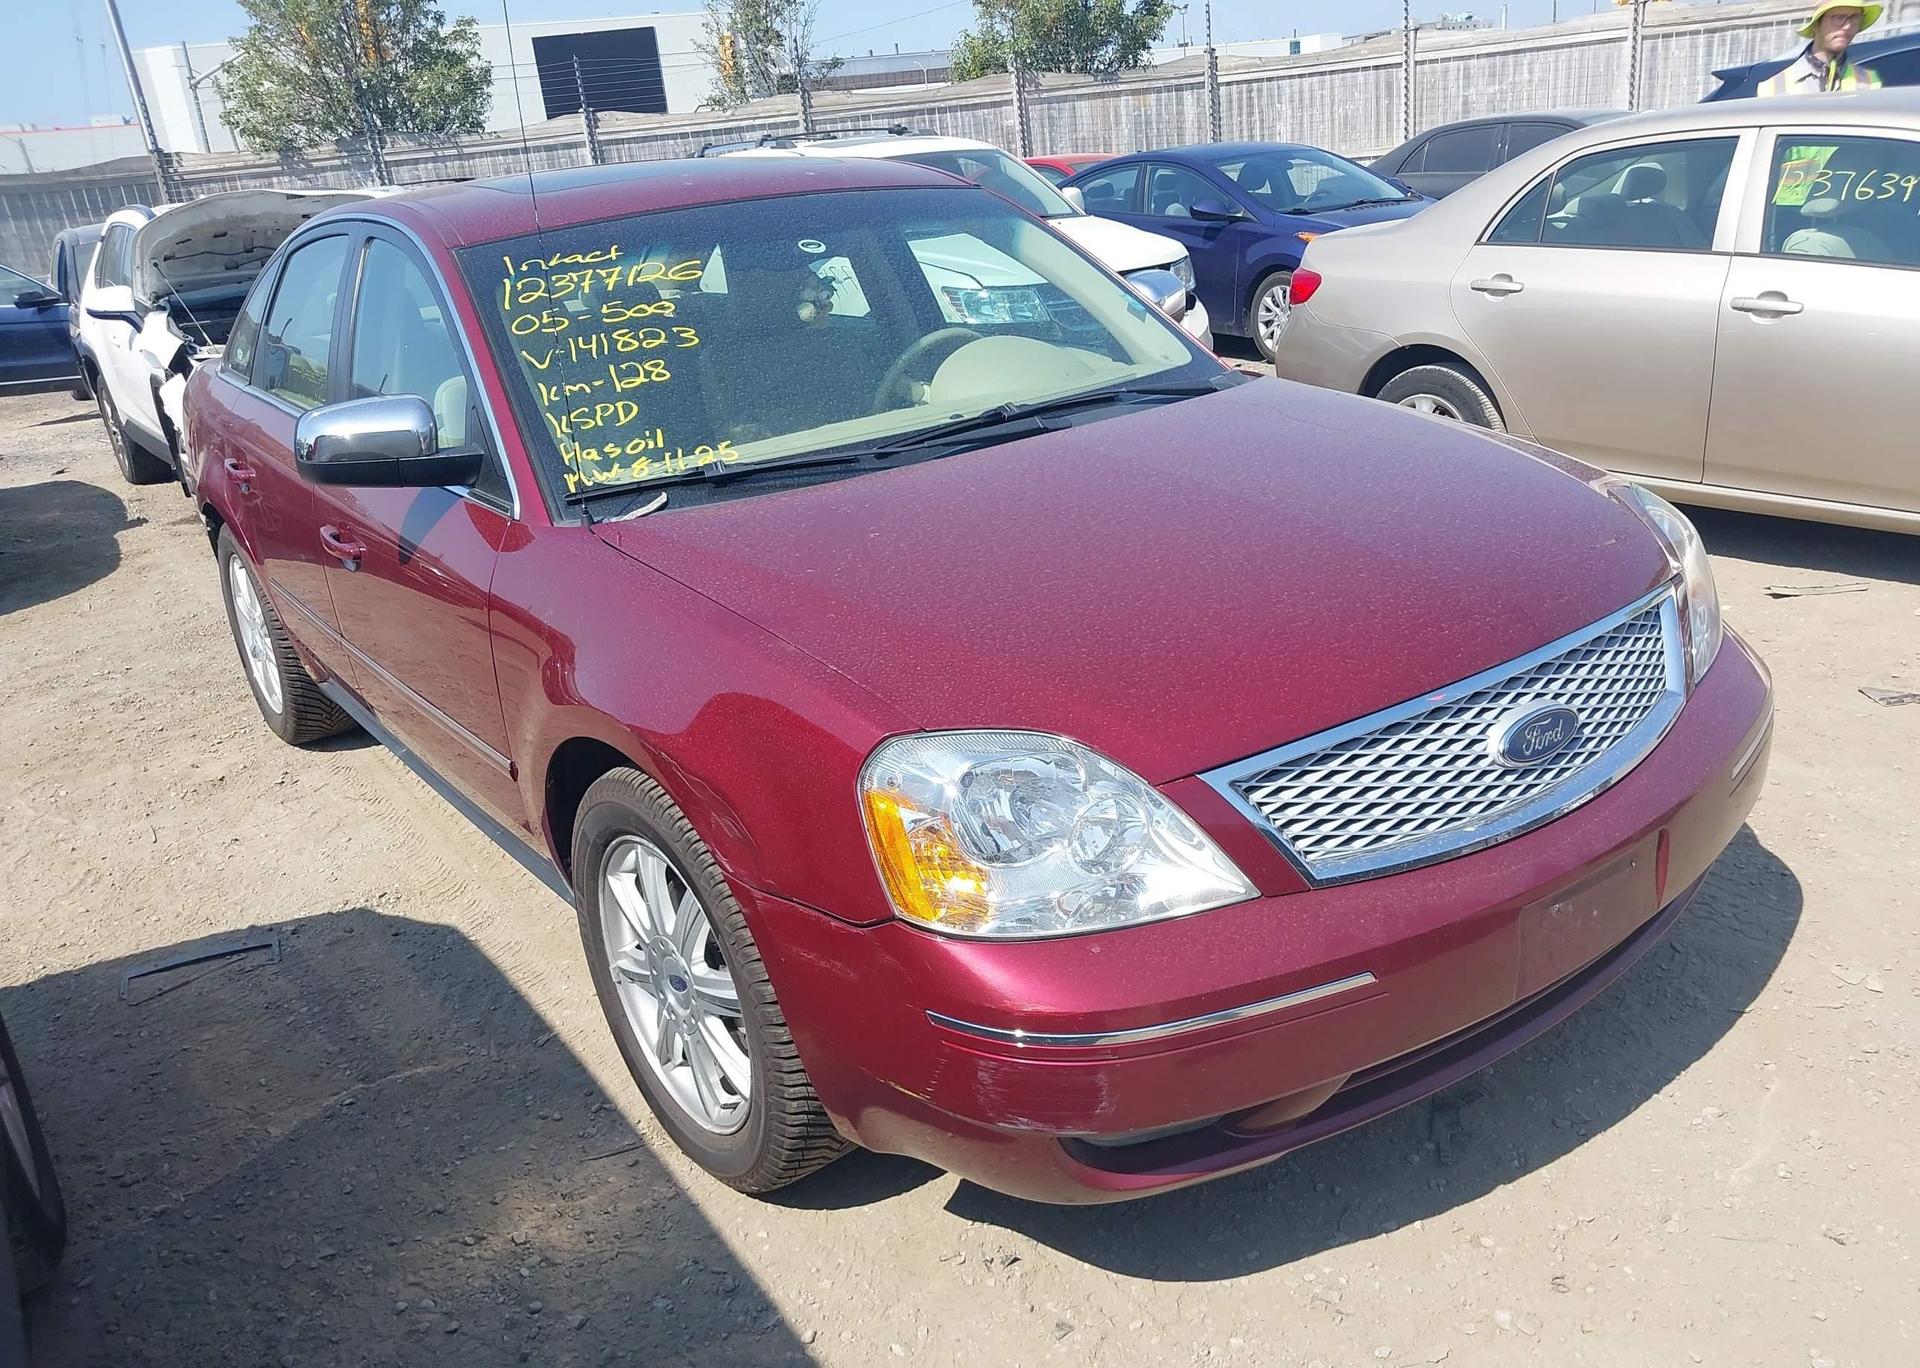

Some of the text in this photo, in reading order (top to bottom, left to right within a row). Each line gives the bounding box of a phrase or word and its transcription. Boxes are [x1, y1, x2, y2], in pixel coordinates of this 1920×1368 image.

[1772, 163, 1920, 203] 1237639
[503, 260, 703, 310] 12377126
[1522, 717, 1564, 756] Ford
